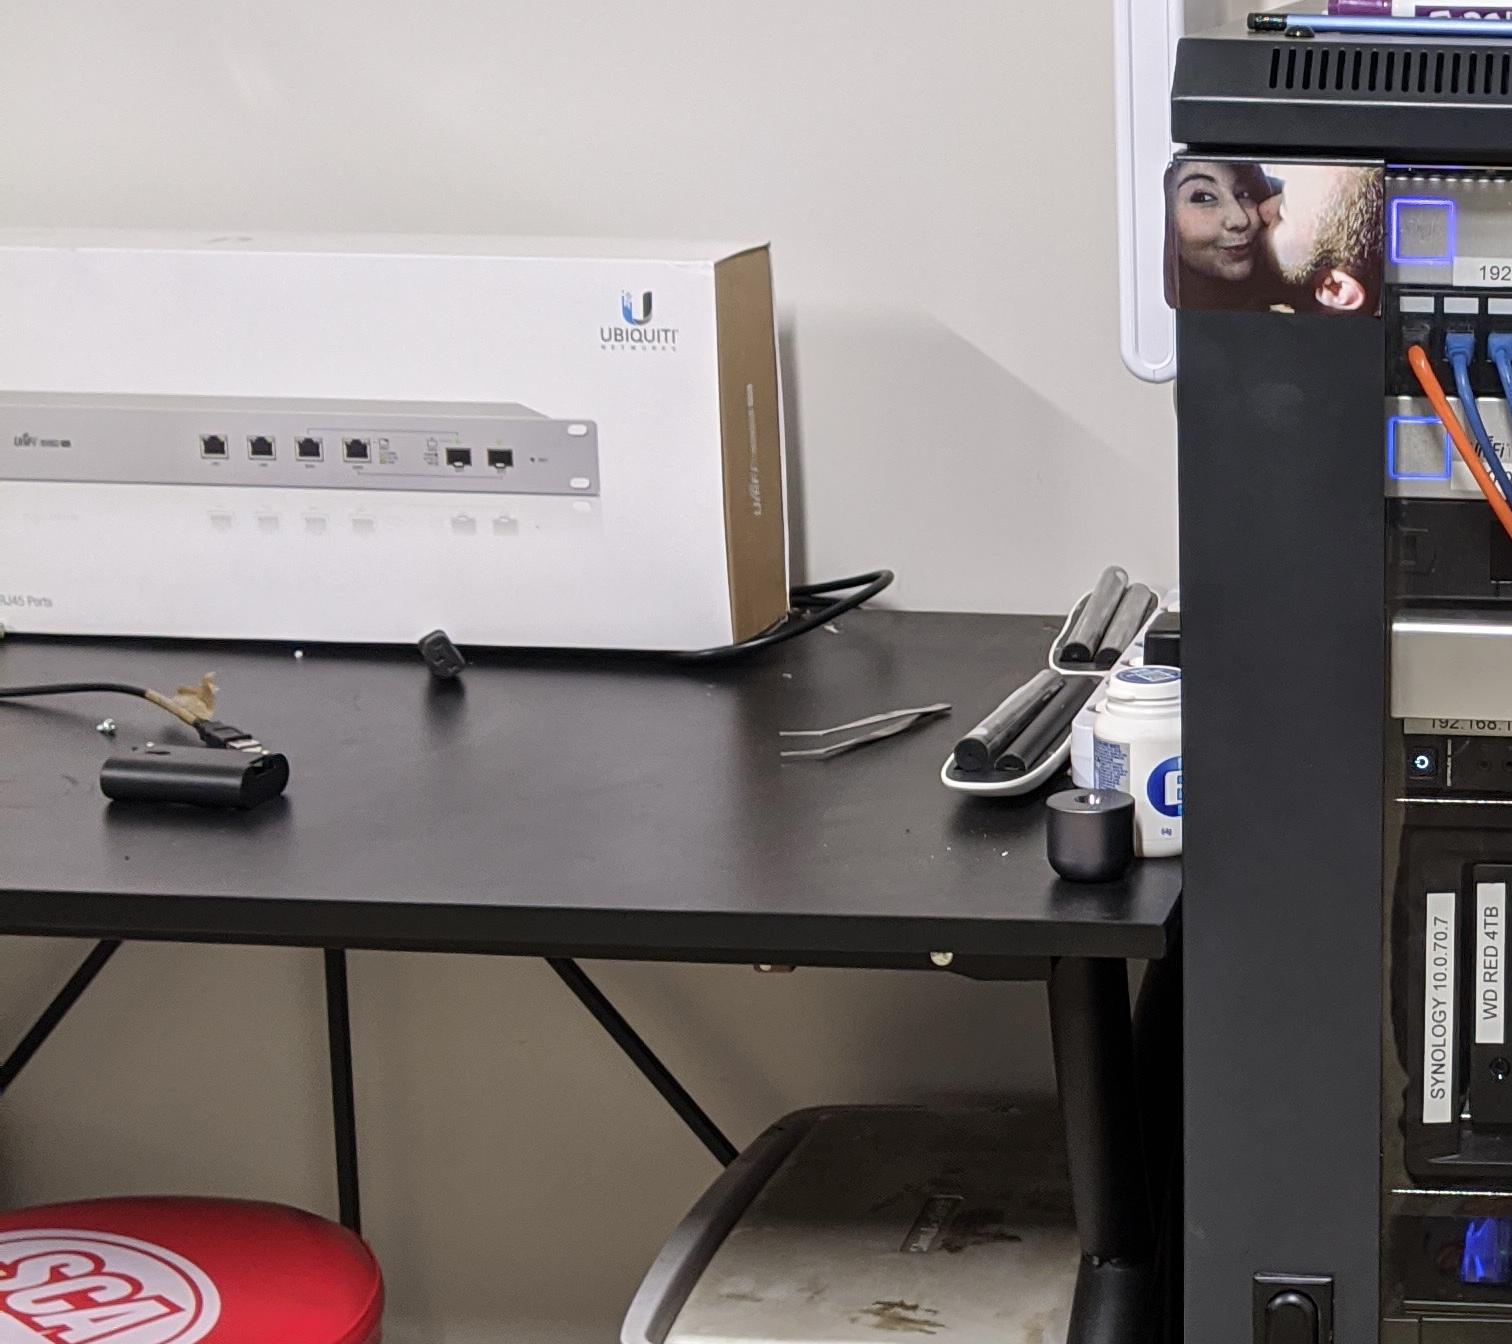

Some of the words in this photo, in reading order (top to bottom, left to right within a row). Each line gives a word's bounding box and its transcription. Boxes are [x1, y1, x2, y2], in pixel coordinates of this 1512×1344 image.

[600, 327, 677, 344] UBIQUITI
[1484, 905, 1499, 940] 4TB
[1433, 915, 1448, 991] 10.0.70.7
[1483, 946, 1499, 984] RED
[1483, 988, 1498, 1020] WD
[1430, 997, 1447, 1100] SYNOLOGY
